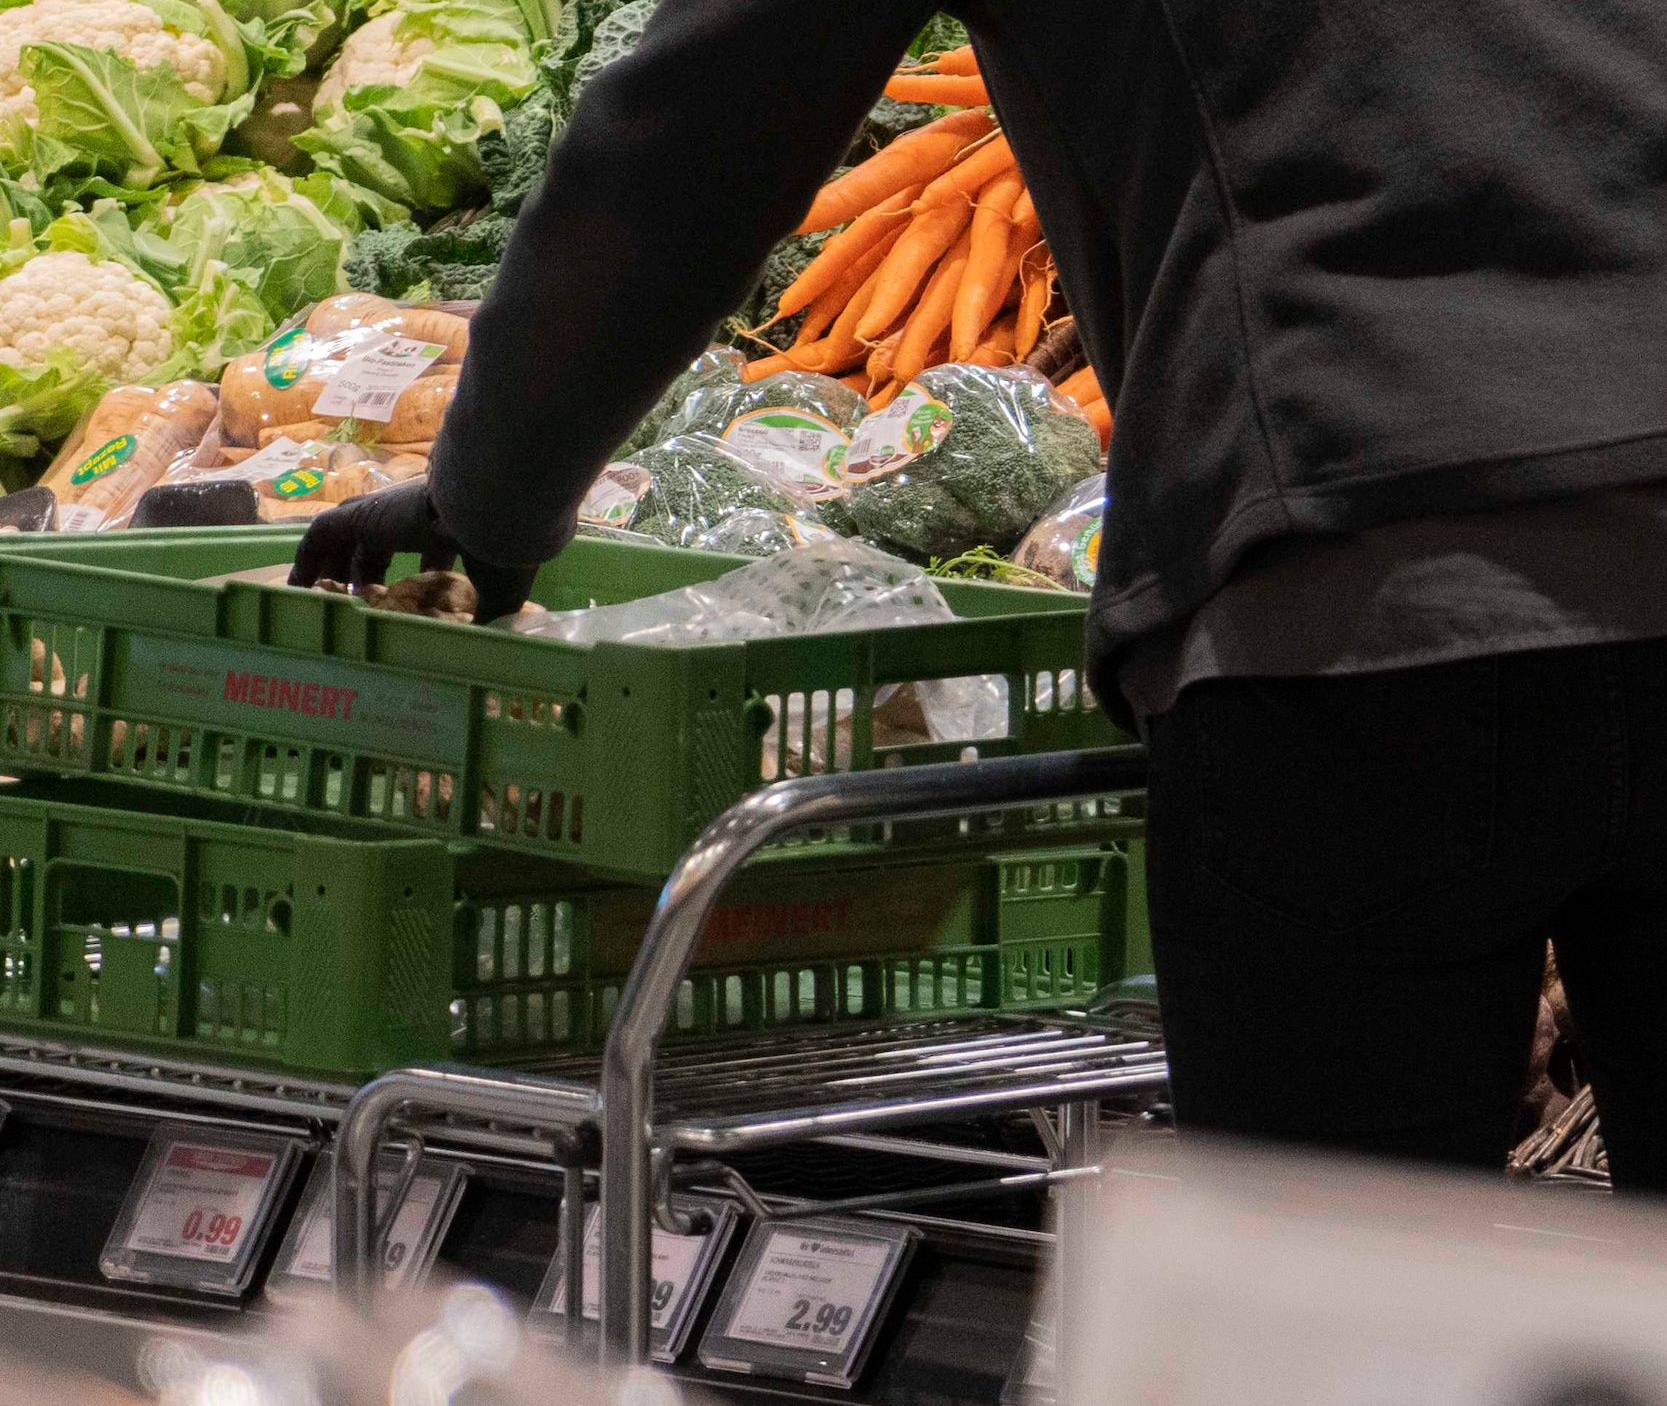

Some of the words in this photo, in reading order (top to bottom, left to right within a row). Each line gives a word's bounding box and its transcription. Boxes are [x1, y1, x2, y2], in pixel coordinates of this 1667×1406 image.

[337, 379, 361, 392] 500g
[223, 670, 359, 721] MEINERT
[181, 1209, 243, 1246] 0.99
[785, 1299, 853, 1336] 2.99
